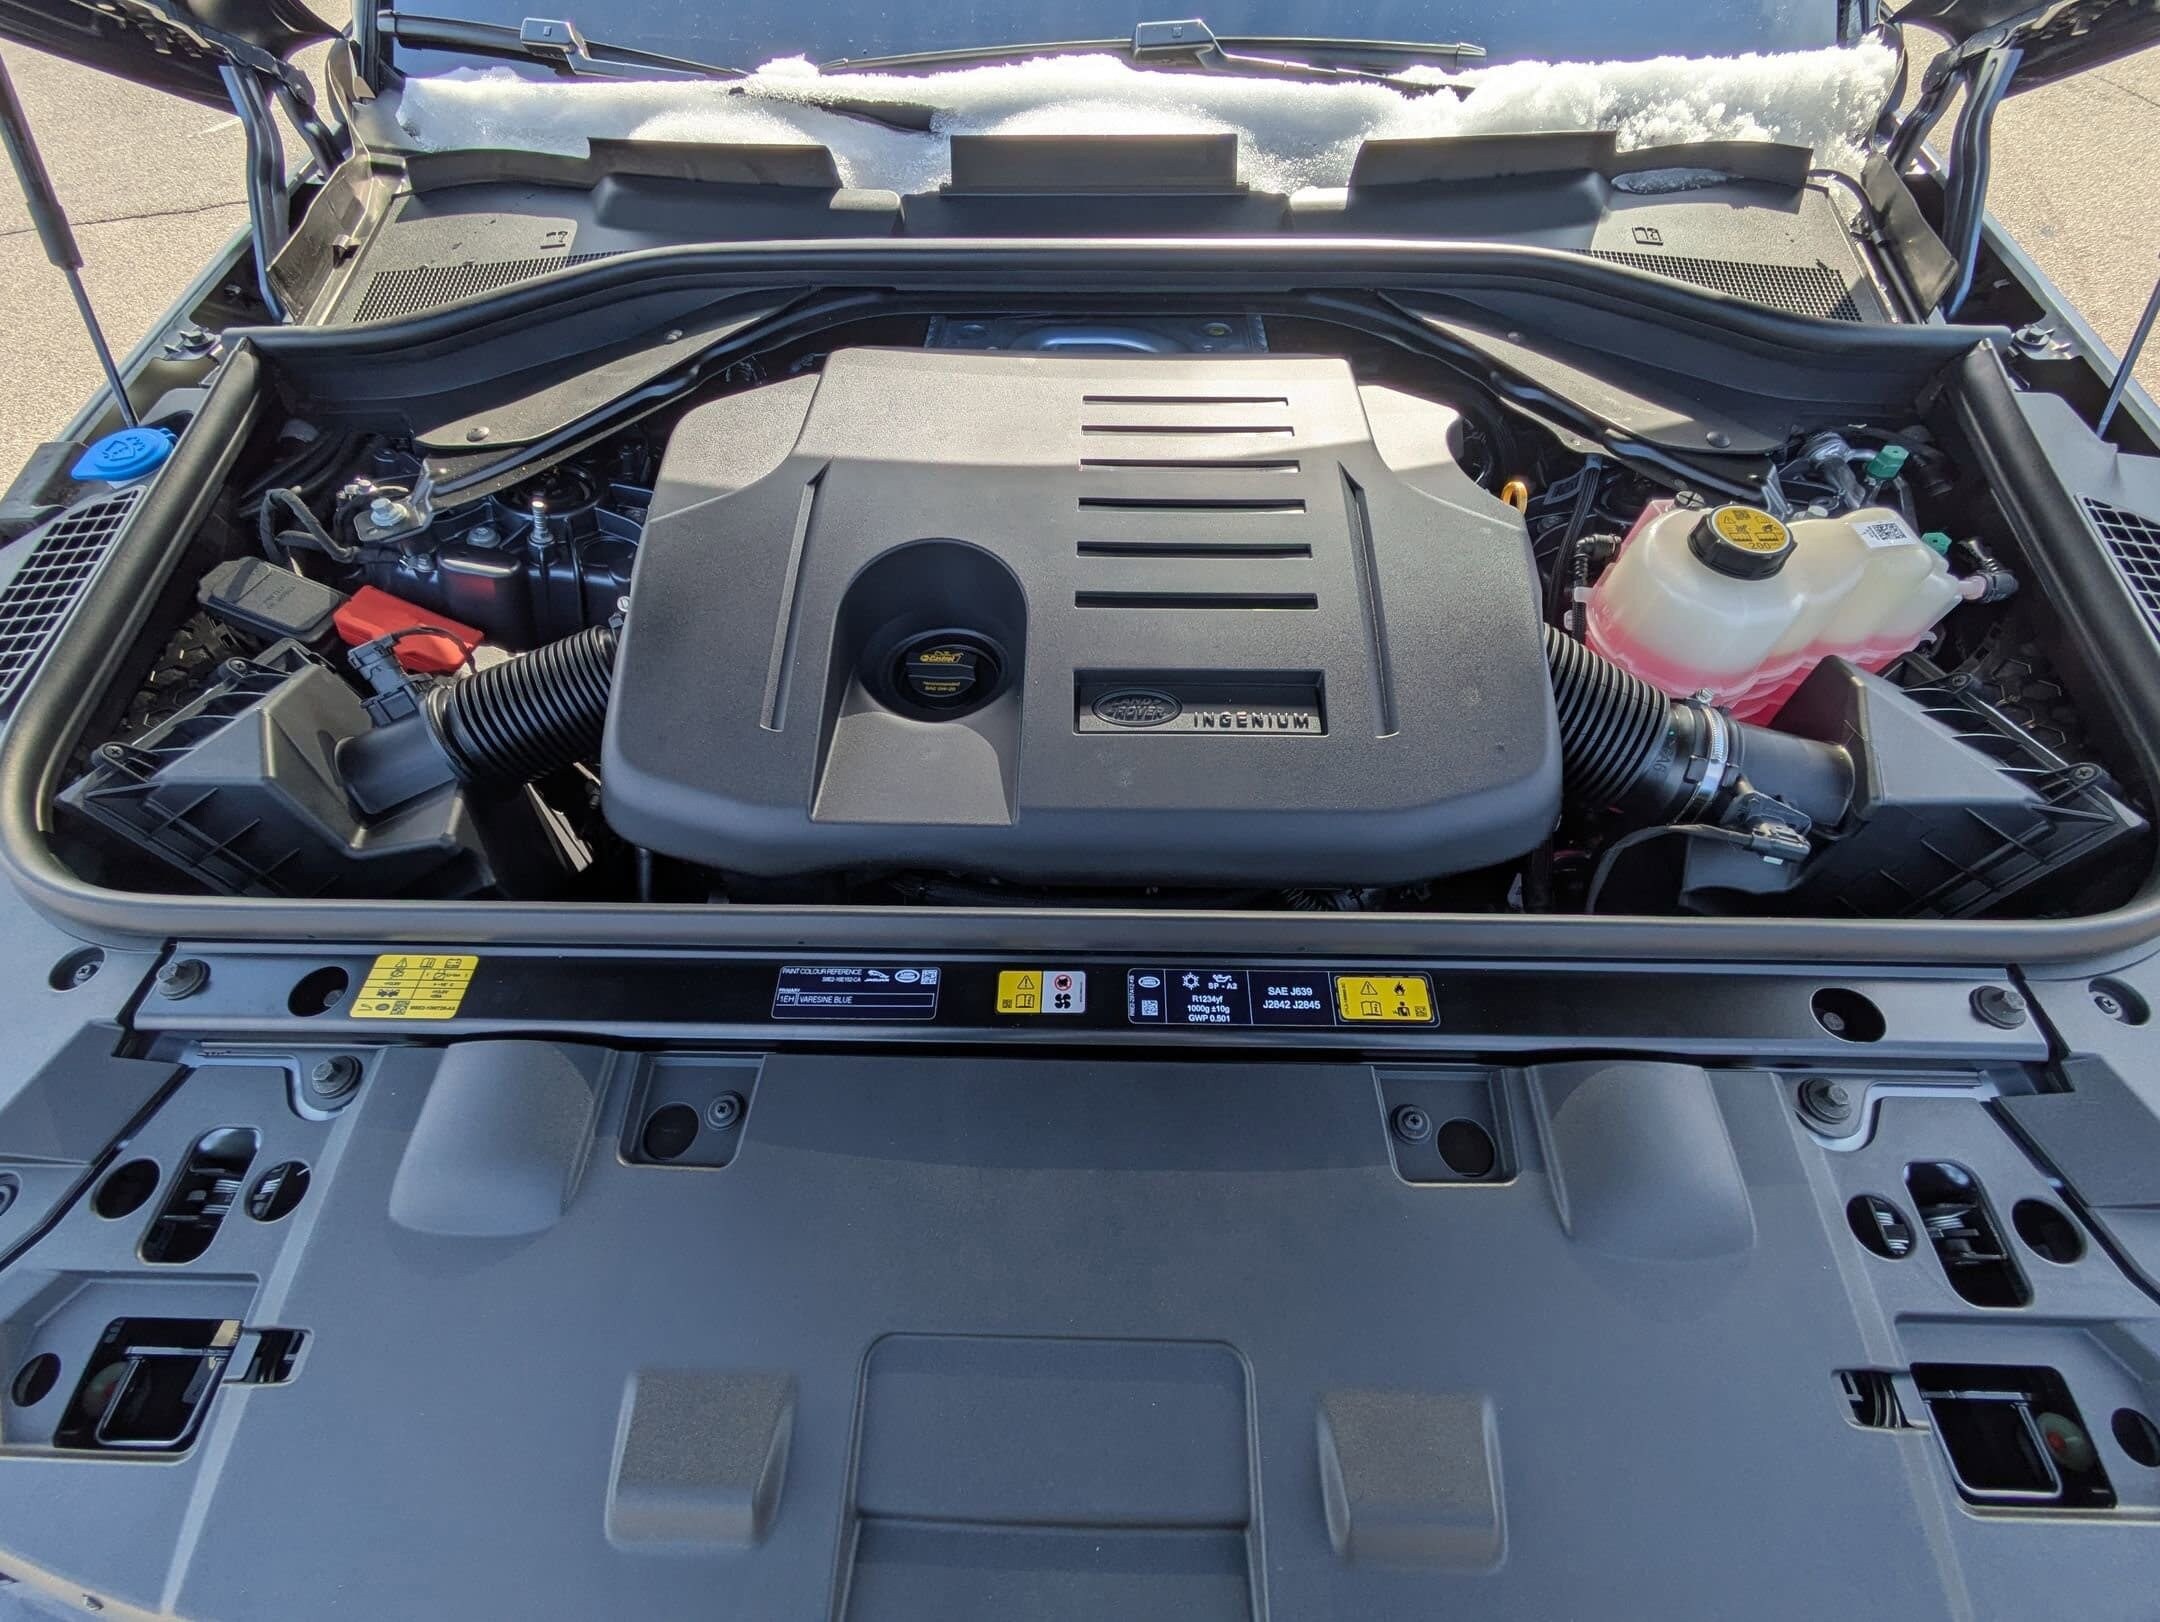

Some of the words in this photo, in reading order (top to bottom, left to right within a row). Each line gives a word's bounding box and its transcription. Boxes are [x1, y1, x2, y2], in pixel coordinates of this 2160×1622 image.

[1111, 705, 1167, 720] ROVER
[1193, 711, 1310, 729] INGENIUM
[800, 968, 827, 976] COLOUR
[827, 968, 863, 977] REFERENCE
[1208, 982, 1220, 990] SP
[1267, 986, 1289, 996] SAE
[1290, 987, 1313, 996] J639
[779, 995, 795, 1003] 1EH
[800, 996, 833, 1004] VARESINE
[1191, 994, 1224, 1004] R1234yf
[1187, 1004, 1210, 1014] 1000g
[1211, 1005, 1231, 1014] ±10g
[1262, 1000, 1291, 1009] J2842
[1292, 1000, 1321, 1010] J2845
[1188, 1014, 1209, 1022] GWP
[1209, 1014, 1231, 1023] 0.501
